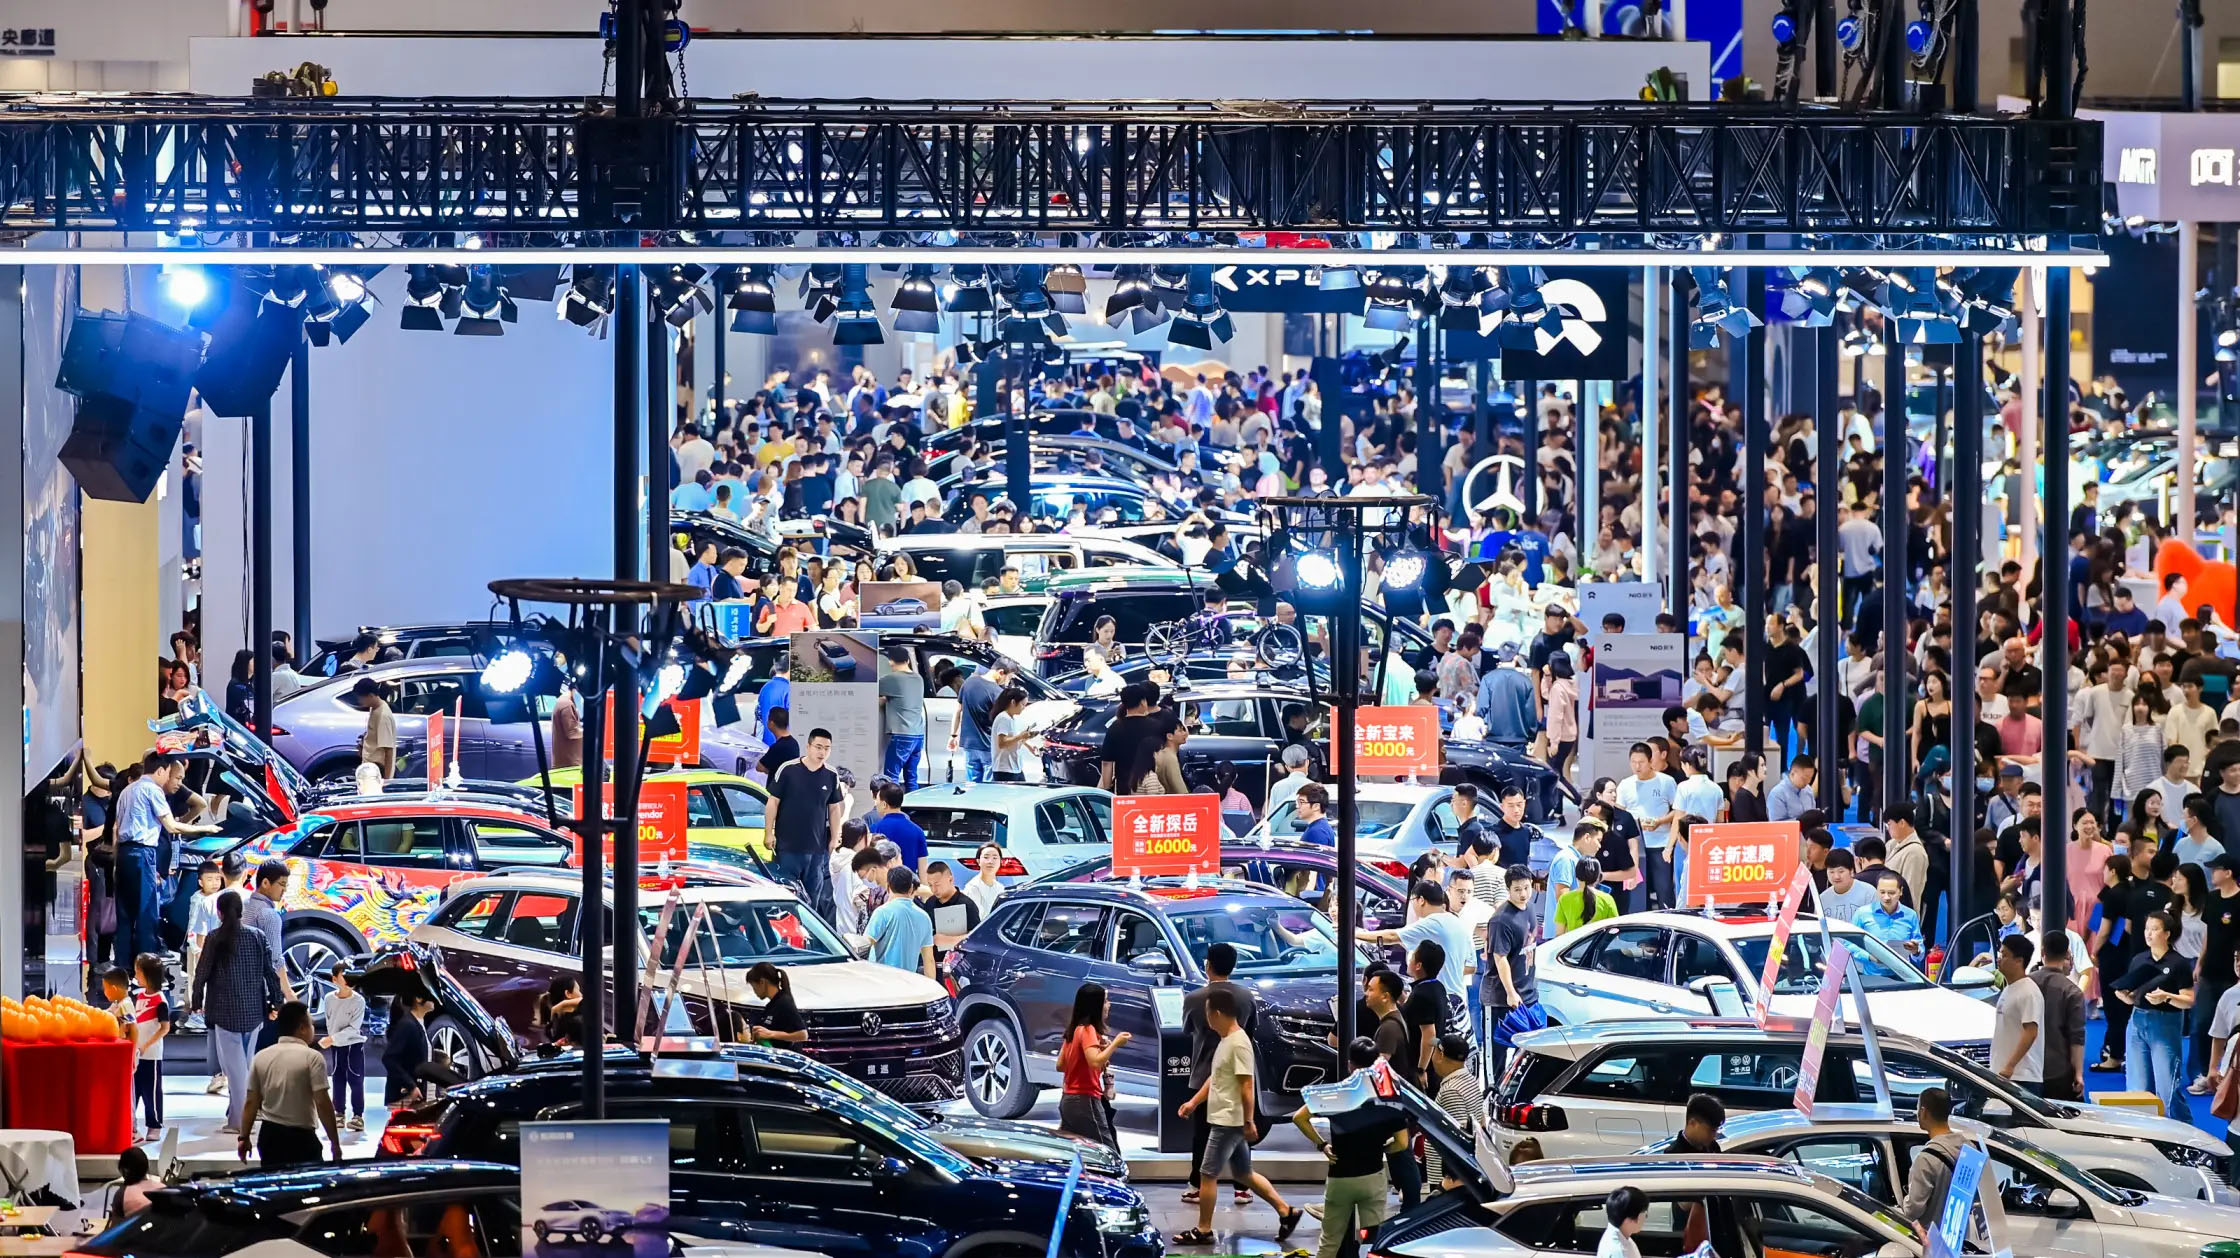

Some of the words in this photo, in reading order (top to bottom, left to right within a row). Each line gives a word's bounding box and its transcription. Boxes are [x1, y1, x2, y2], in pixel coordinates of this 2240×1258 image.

[1354, 724, 1415, 741] 全新宝来
[1133, 812, 1198, 834] 全新探岳
[1708, 843, 1775, 865] 全新速腾
